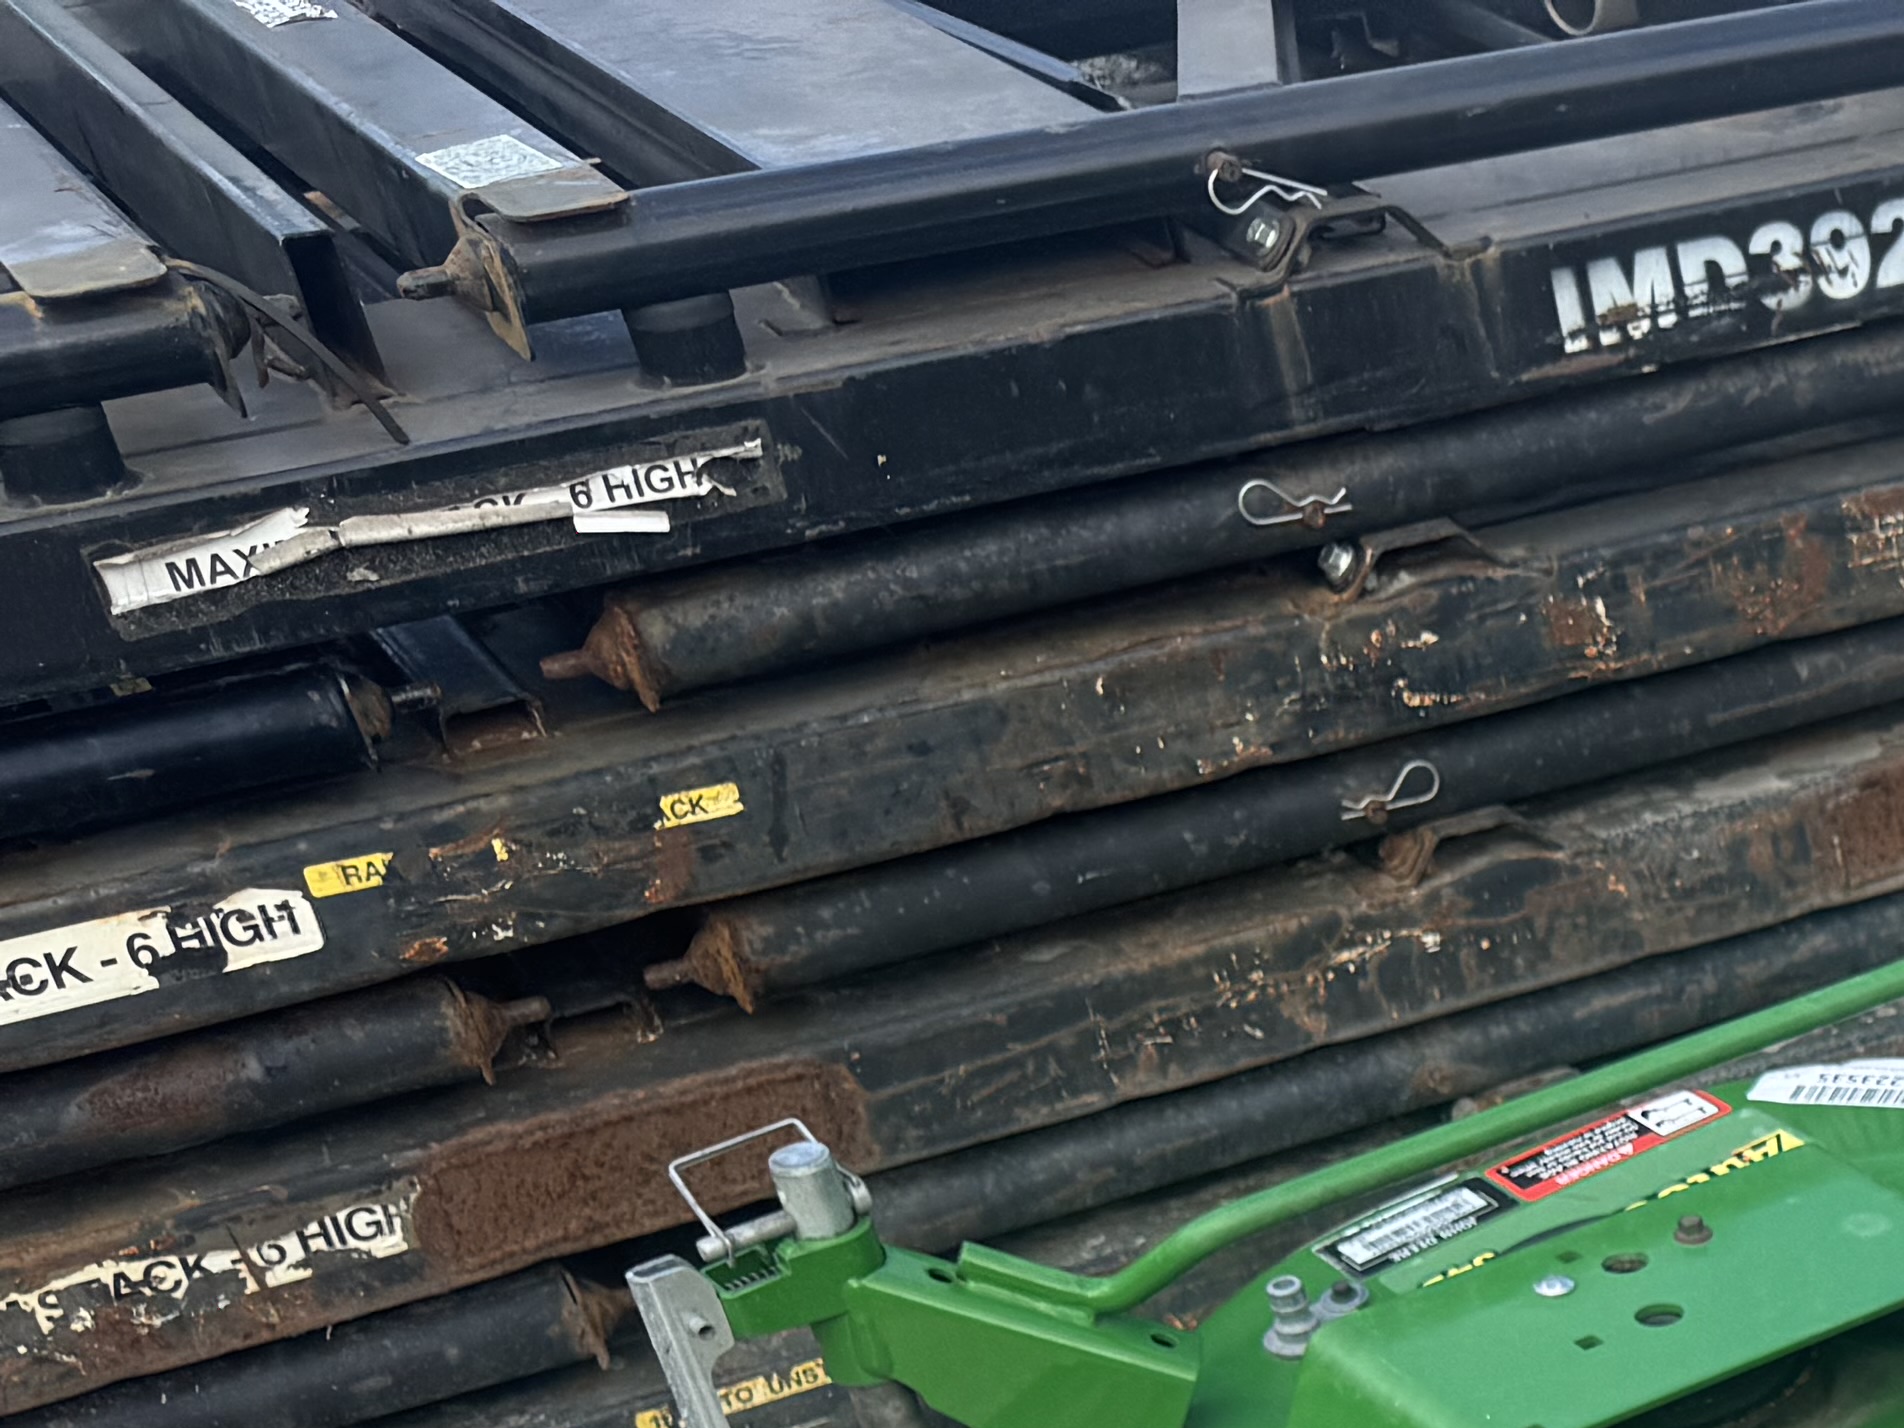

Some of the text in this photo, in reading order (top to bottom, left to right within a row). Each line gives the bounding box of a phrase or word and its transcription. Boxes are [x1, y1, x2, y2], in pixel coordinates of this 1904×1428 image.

[569, 480, 592, 509] 6
[602, 457, 702, 503] HIGH
[661, 797, 709, 823] CK
[339, 853, 392, 887] RA
[126, 932, 155, 970] 6
[168, 898, 302, 949] HIGH
[38, 1254, 212, 1322] SACK
